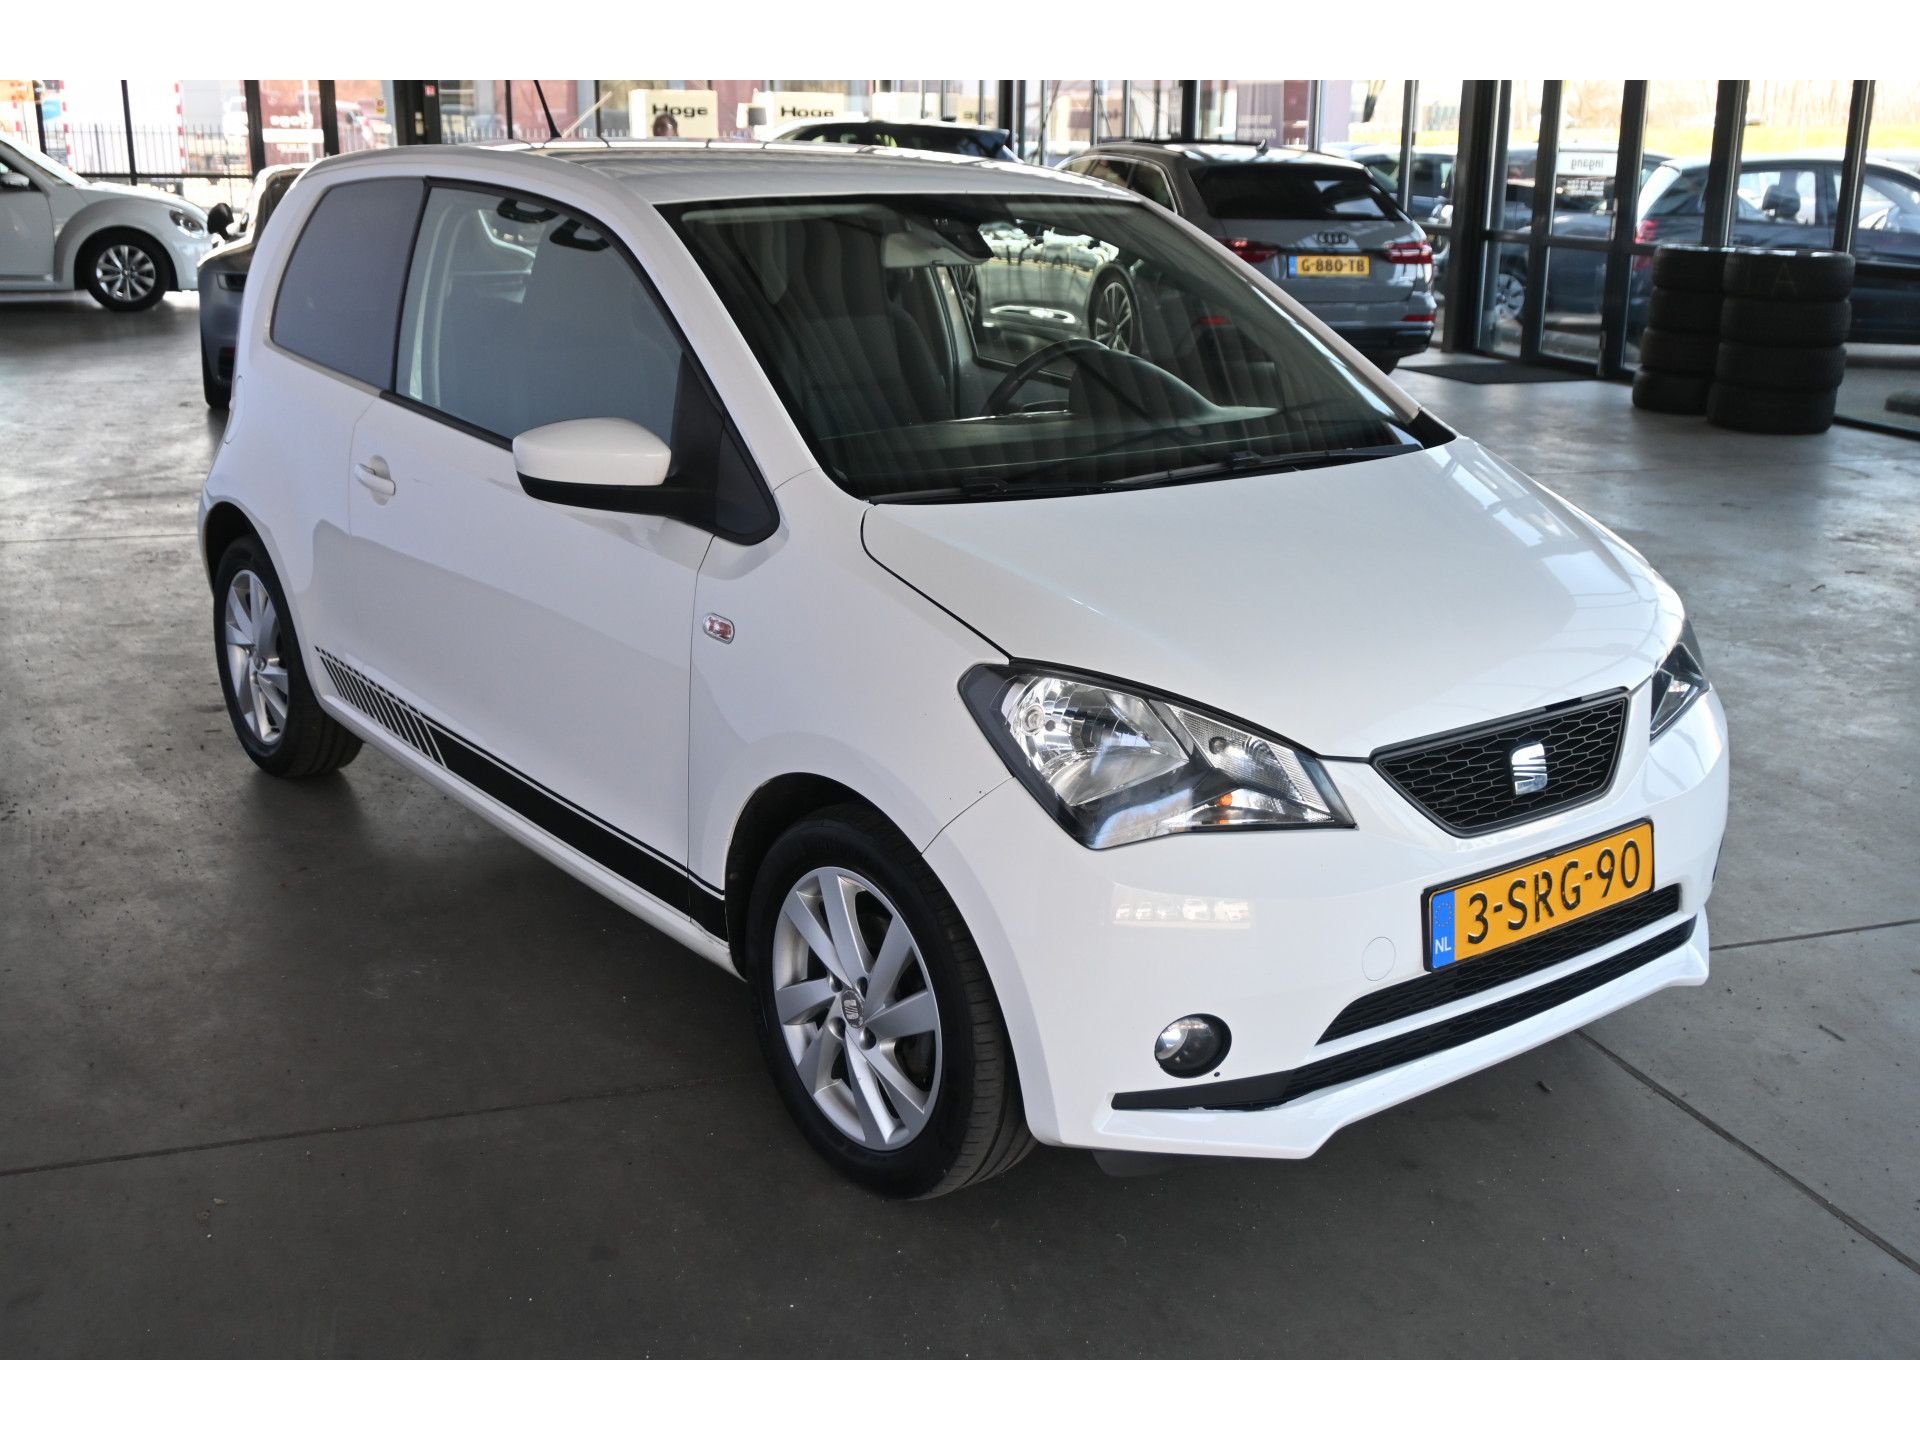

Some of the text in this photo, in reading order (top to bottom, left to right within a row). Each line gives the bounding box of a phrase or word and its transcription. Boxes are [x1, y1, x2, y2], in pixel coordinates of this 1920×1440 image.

[653, 104, 708, 117] Hoge
[1302, 258, 1365, 272] G-880-TB
[1467, 838, 1641, 945] 3-SRG-90
[1435, 936, 1452, 954] NL
